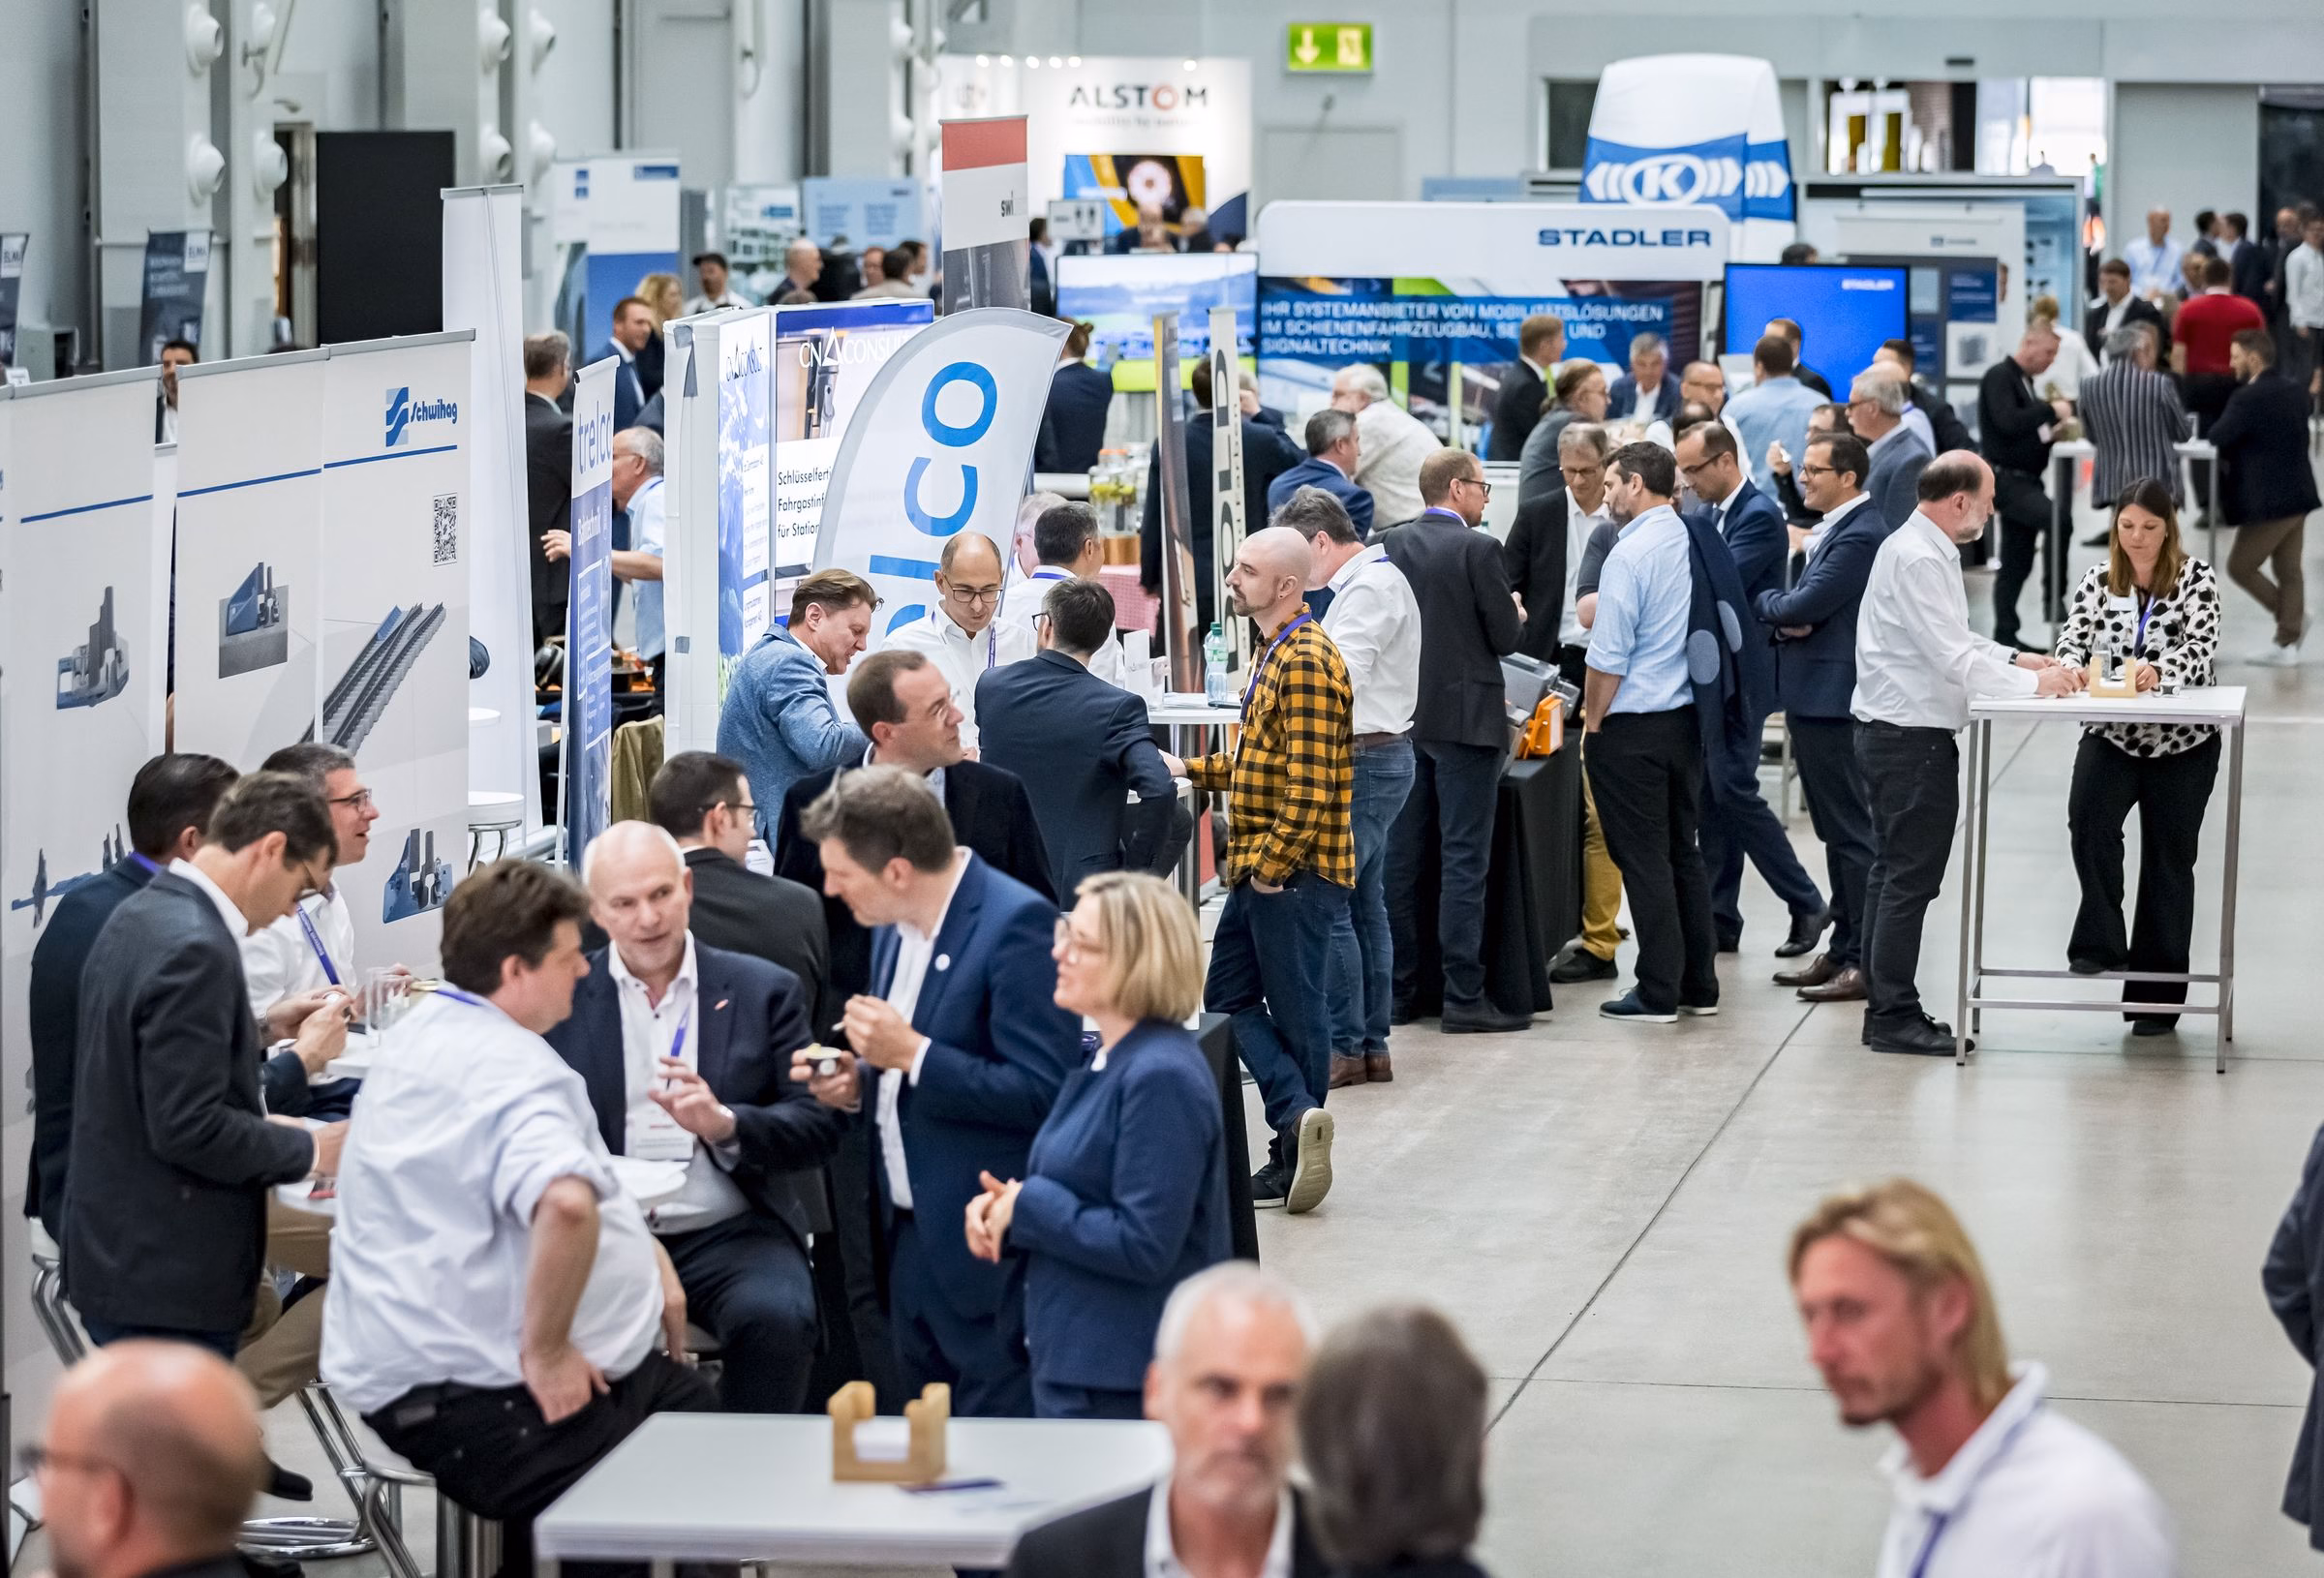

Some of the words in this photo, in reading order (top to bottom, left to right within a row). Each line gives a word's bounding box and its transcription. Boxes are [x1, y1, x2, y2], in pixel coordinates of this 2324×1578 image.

[1069, 85, 1208, 109] ALSTOM
[1538, 228, 1712, 247] STADLER
[1261, 301, 1291, 318] IHR
[1293, 301, 1438, 319] SYSTEMANBIETER
[1440, 302, 1476, 319] VON
[1261, 319, 1282, 335] IM
[1568, 322, 1606, 340] UND
[1261, 337, 1392, 354] SIGNALTECHNIK
[411, 398, 458, 424] Schwihag
[778, 523, 790, 538] für
